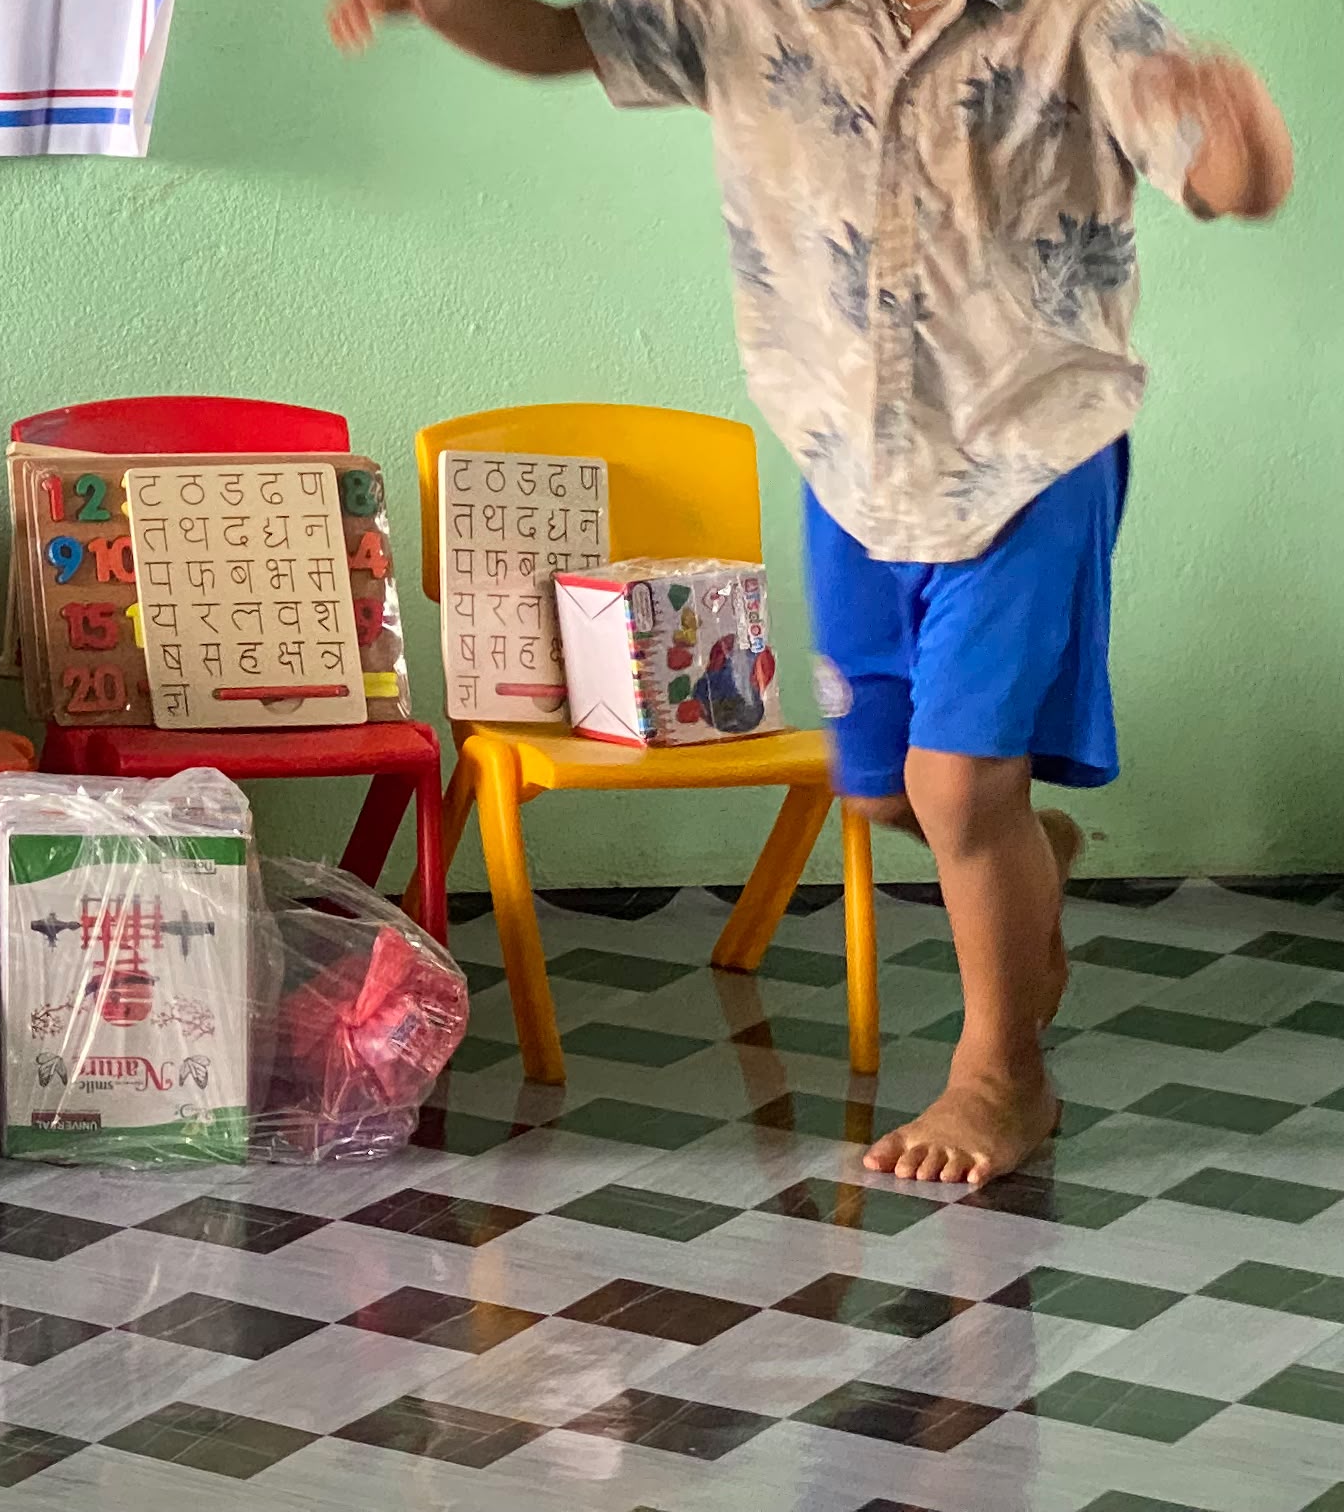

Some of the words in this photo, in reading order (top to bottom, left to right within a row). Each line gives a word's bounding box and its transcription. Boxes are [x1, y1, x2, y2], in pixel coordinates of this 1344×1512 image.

[41, 475, 64, 522] 1
[76, 473, 111, 522] 2
[341, 470, 378, 517] 8
[135, 476, 161, 506] ट
[176, 474, 205, 505] ठ
[217, 473, 244, 506] ड
[257, 472, 284, 505] ढ
[297, 471, 325, 505] ण
[451, 459, 473, 492] ट
[483, 460, 506, 493] ठ
[516, 462, 538, 496] ड
[547, 464, 568, 498] ढ
[578, 465, 600, 501] ण
[139, 517, 169, 552] त
[179, 517, 210, 552] थ
[221, 516, 251, 548] द
[262, 515, 290, 549] ध
[302, 514, 331, 548] न
[451, 503, 475, 539] त
[482, 504, 507, 541] थ
[516, 506, 539, 540] द
[547, 508, 570, 542] ध
[580, 509, 600, 545] न
[47, 535, 83, 584] 9
[88, 536, 136, 584] 10
[348, 531, 389, 579] 4
[451, 548, 475, 585] प
[485, 549, 508, 586] फ
[517, 551, 540, 587] ब
[144, 561, 173, 596] प
[185, 560, 215, 597] फ
[225, 559, 255, 594] ब
[265, 558, 297, 593] भ
[307, 557, 336, 593] म
[61, 602, 118, 651] 15
[148, 603, 178, 637] य
[191, 602, 221, 634] र
[231, 601, 263, 635] ल
[273, 601, 302, 634] व
[311, 600, 341, 633] श
[453, 592, 475, 627] य
[487, 594, 510, 626] र
[516, 595, 543, 629] ल
[159, 643, 183, 678] ष
[198, 642, 223, 677] स
[236, 642, 264, 675] ह
[277, 640, 305, 676] क्ष
[315, 641, 345, 676] त्र
[459, 634, 476, 669] ष
[490, 635, 506, 671] स
[519, 636, 540, 670] ह
[63, 663, 127, 713] 20
[160, 683, 190, 718] ज्ञ
[456, 675, 480, 710] ज्ञ
[71, 1055, 174, 1091] Nature
[78, 1080, 115, 1093] smile
